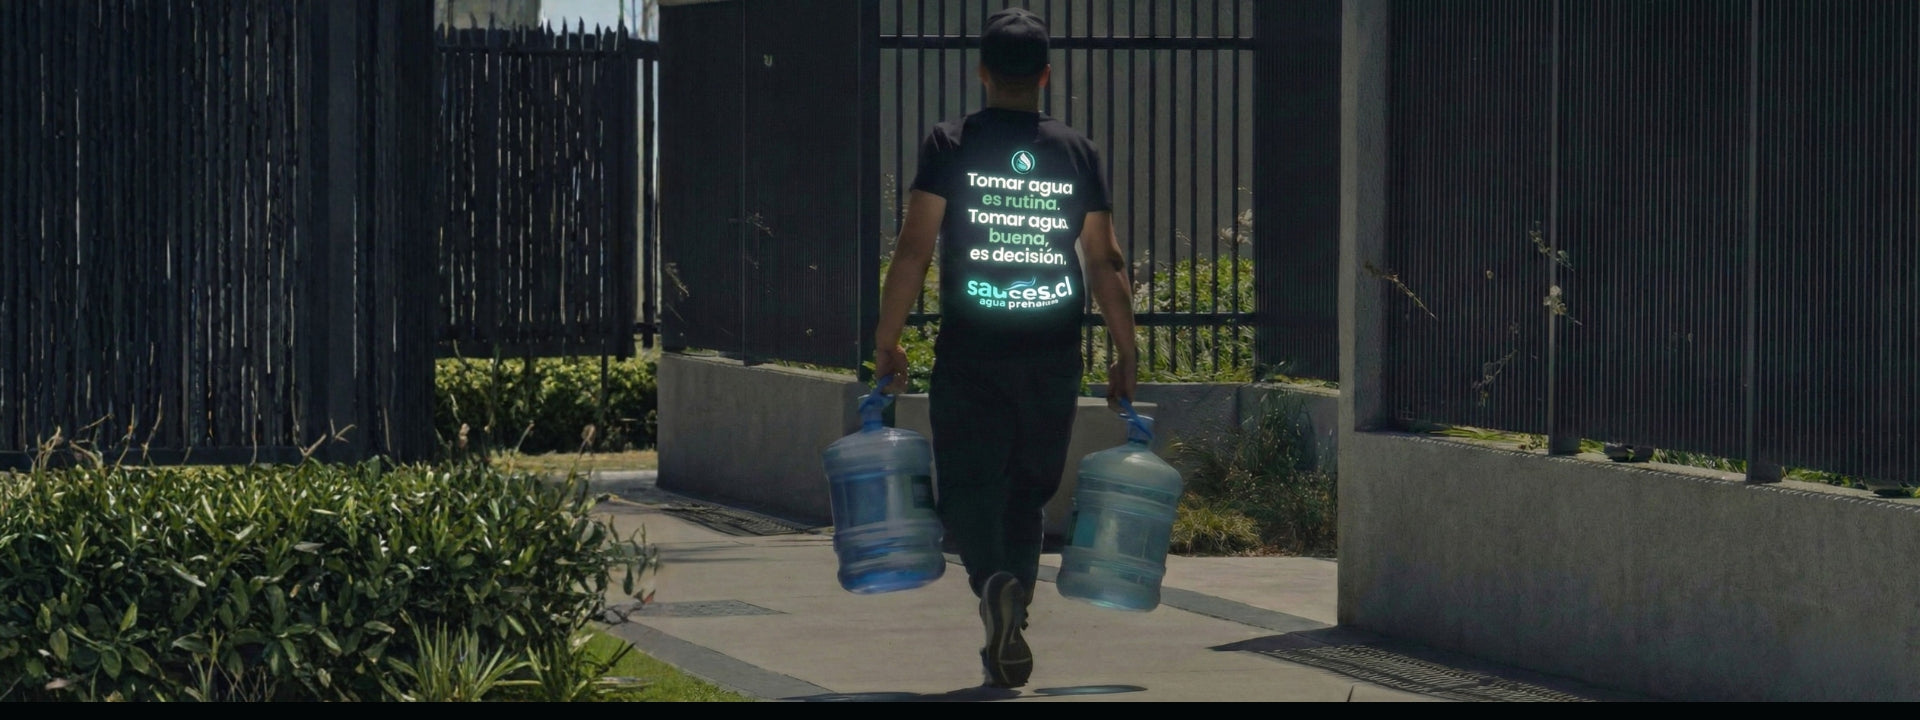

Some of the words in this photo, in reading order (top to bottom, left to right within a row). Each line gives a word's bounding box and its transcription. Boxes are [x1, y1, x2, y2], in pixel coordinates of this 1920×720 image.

[967, 172, 1024, 190] Tomar
[1028, 180, 1073, 197] agua
[982, 194, 1002, 206] es
[1005, 194, 1060, 211] rutina.
[968, 208, 1025, 226] Tomar
[989, 227, 1049, 247] buena,
[970, 248, 989, 261] es
[992, 247, 1067, 265] decisión.
[967, 276, 1072, 300] sauces.cl
[979, 298, 1006, 308] agua
